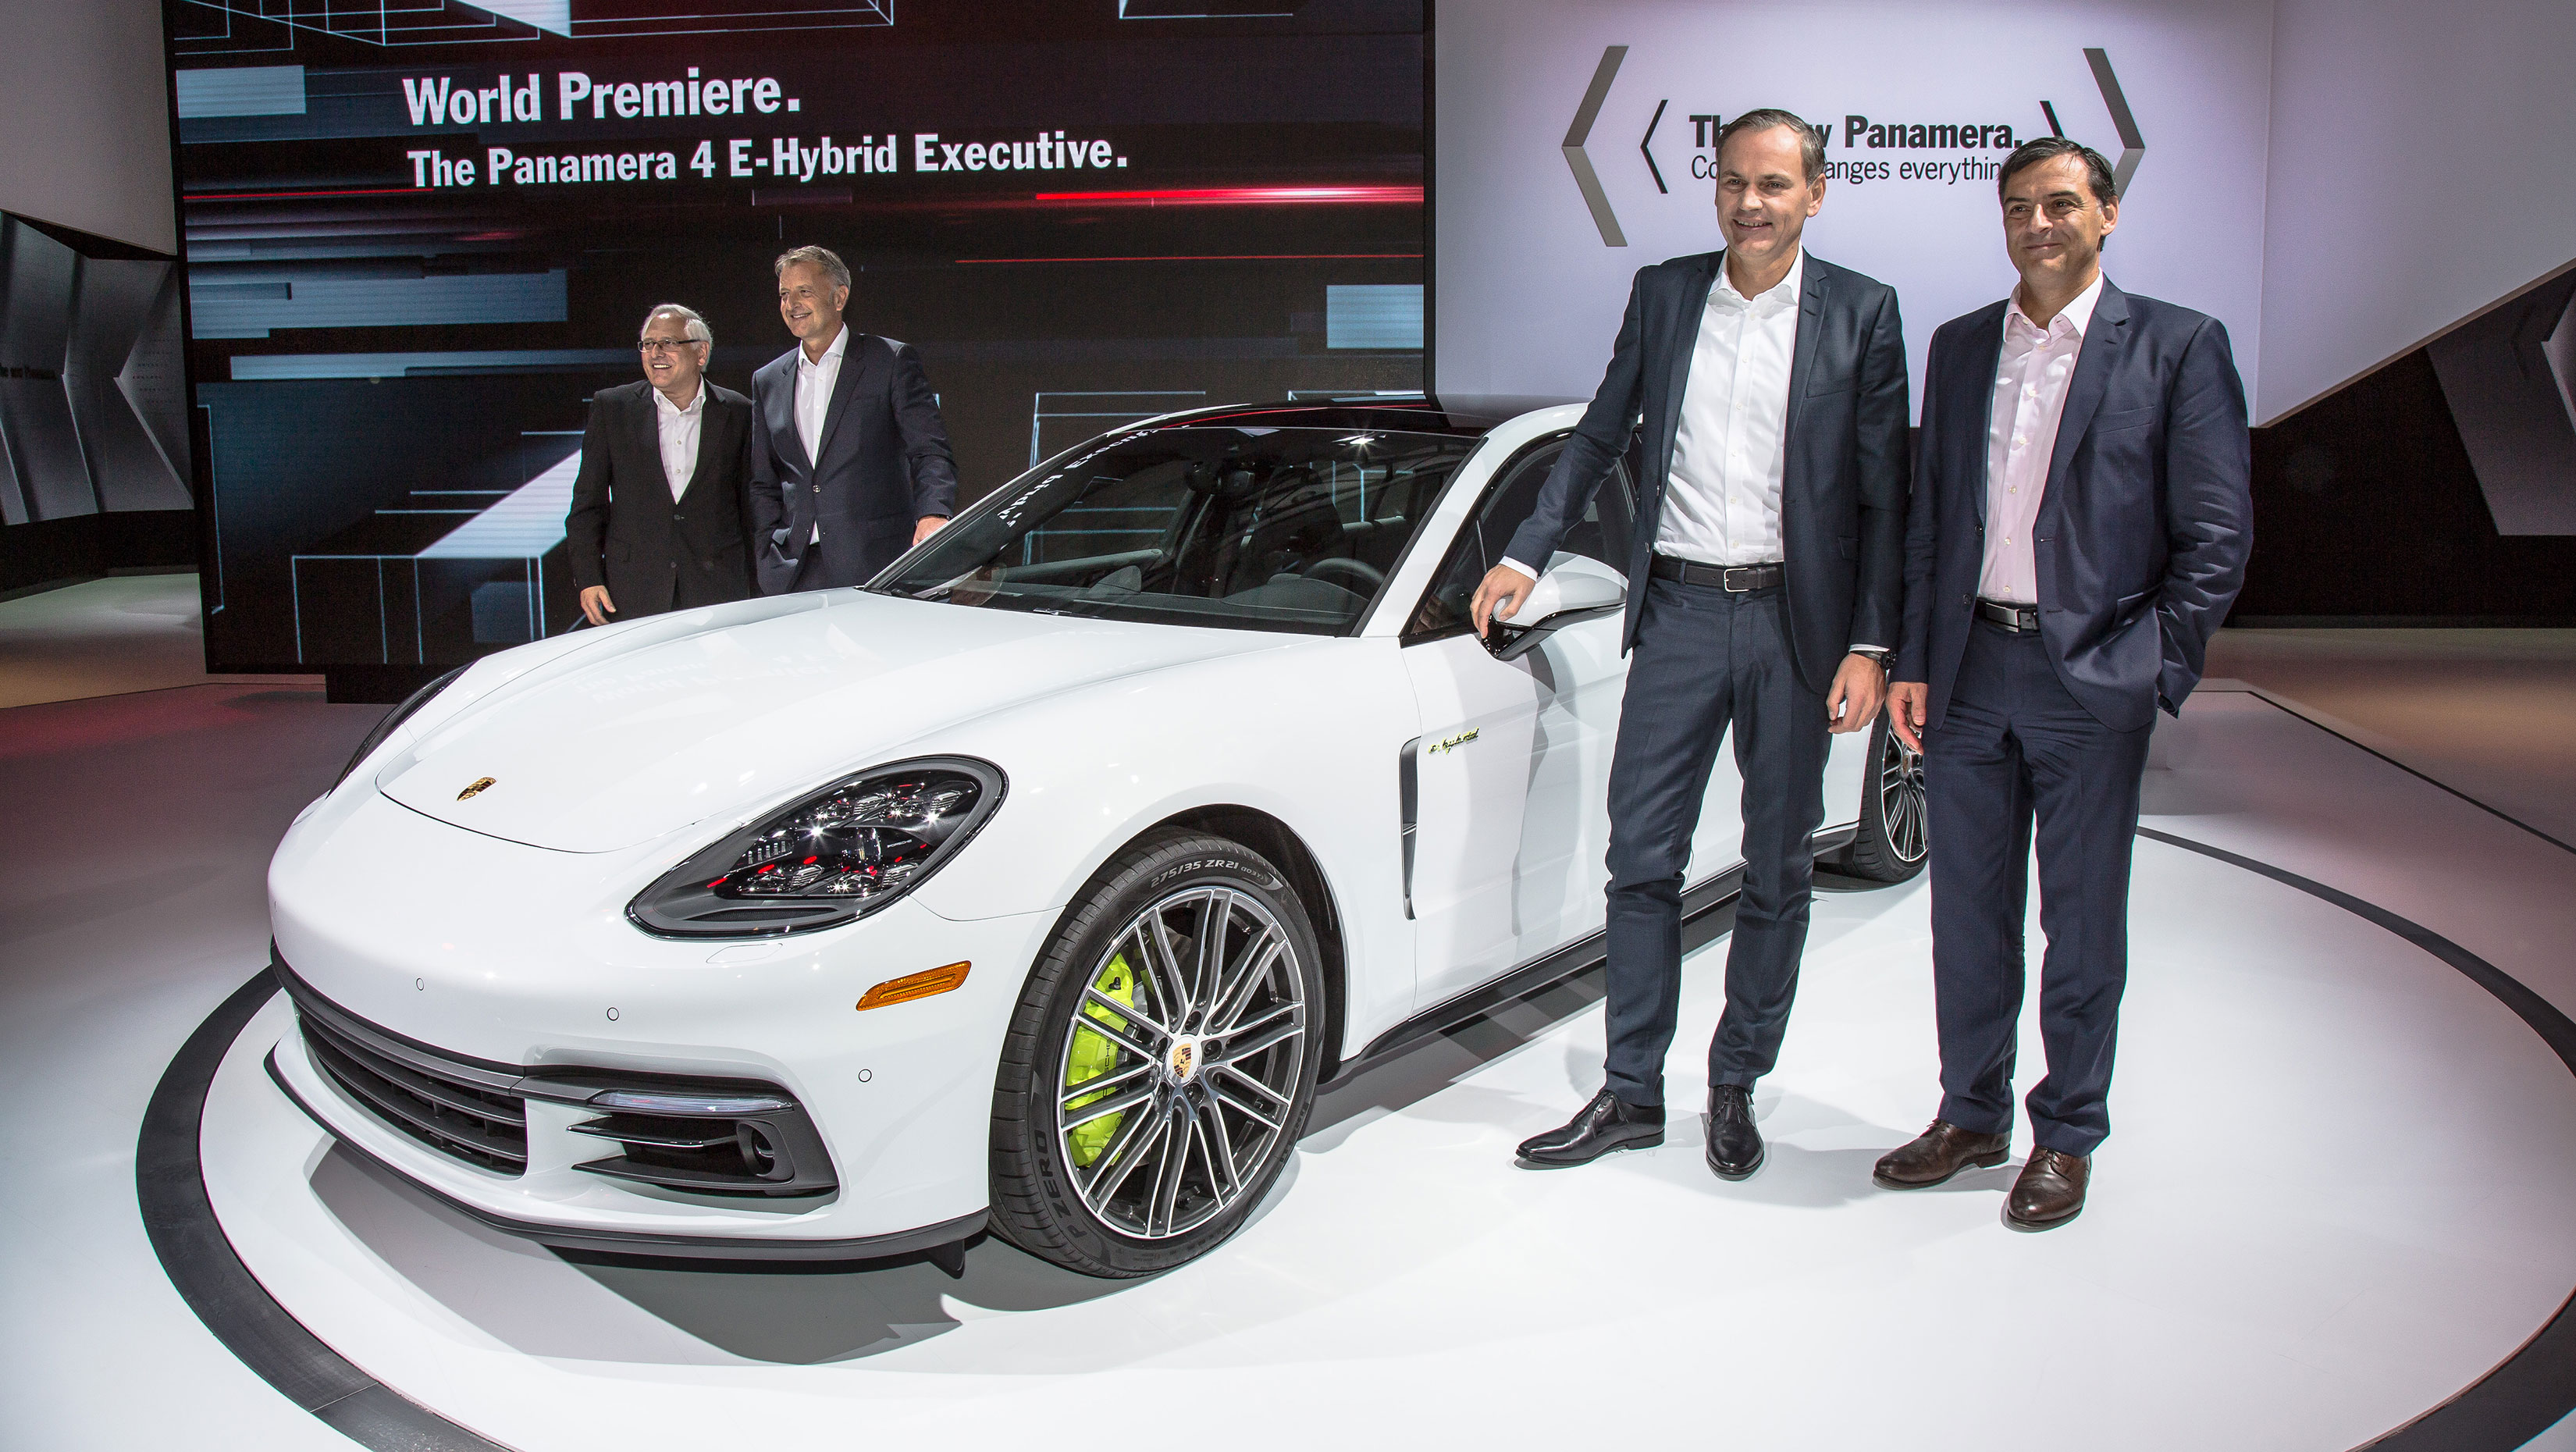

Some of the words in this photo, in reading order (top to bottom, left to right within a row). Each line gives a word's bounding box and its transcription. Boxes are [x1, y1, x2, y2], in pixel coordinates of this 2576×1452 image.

[403, 73, 541, 125] World
[559, 67, 800, 120] Premiere.
[1688, 115, 1729, 148] Th
[1845, 115, 2023, 149] Panamera.
[407, 150, 475, 187] The
[489, 148, 676, 185] Panamera
[690, 141, 716, 178] 4
[729, 134, 897, 183] E-Hybrid
[915, 130, 1127, 172] Executive.
[1824, 161, 1890, 185] anges
[1899, 156, 2003, 185] everythin
[1151, 860, 1202, 888] 275/35
[1204, 859, 1239, 870] ZR21
[1034, 1129, 1073, 1219] ZERO
[1066, 1224, 1088, 1239] P
